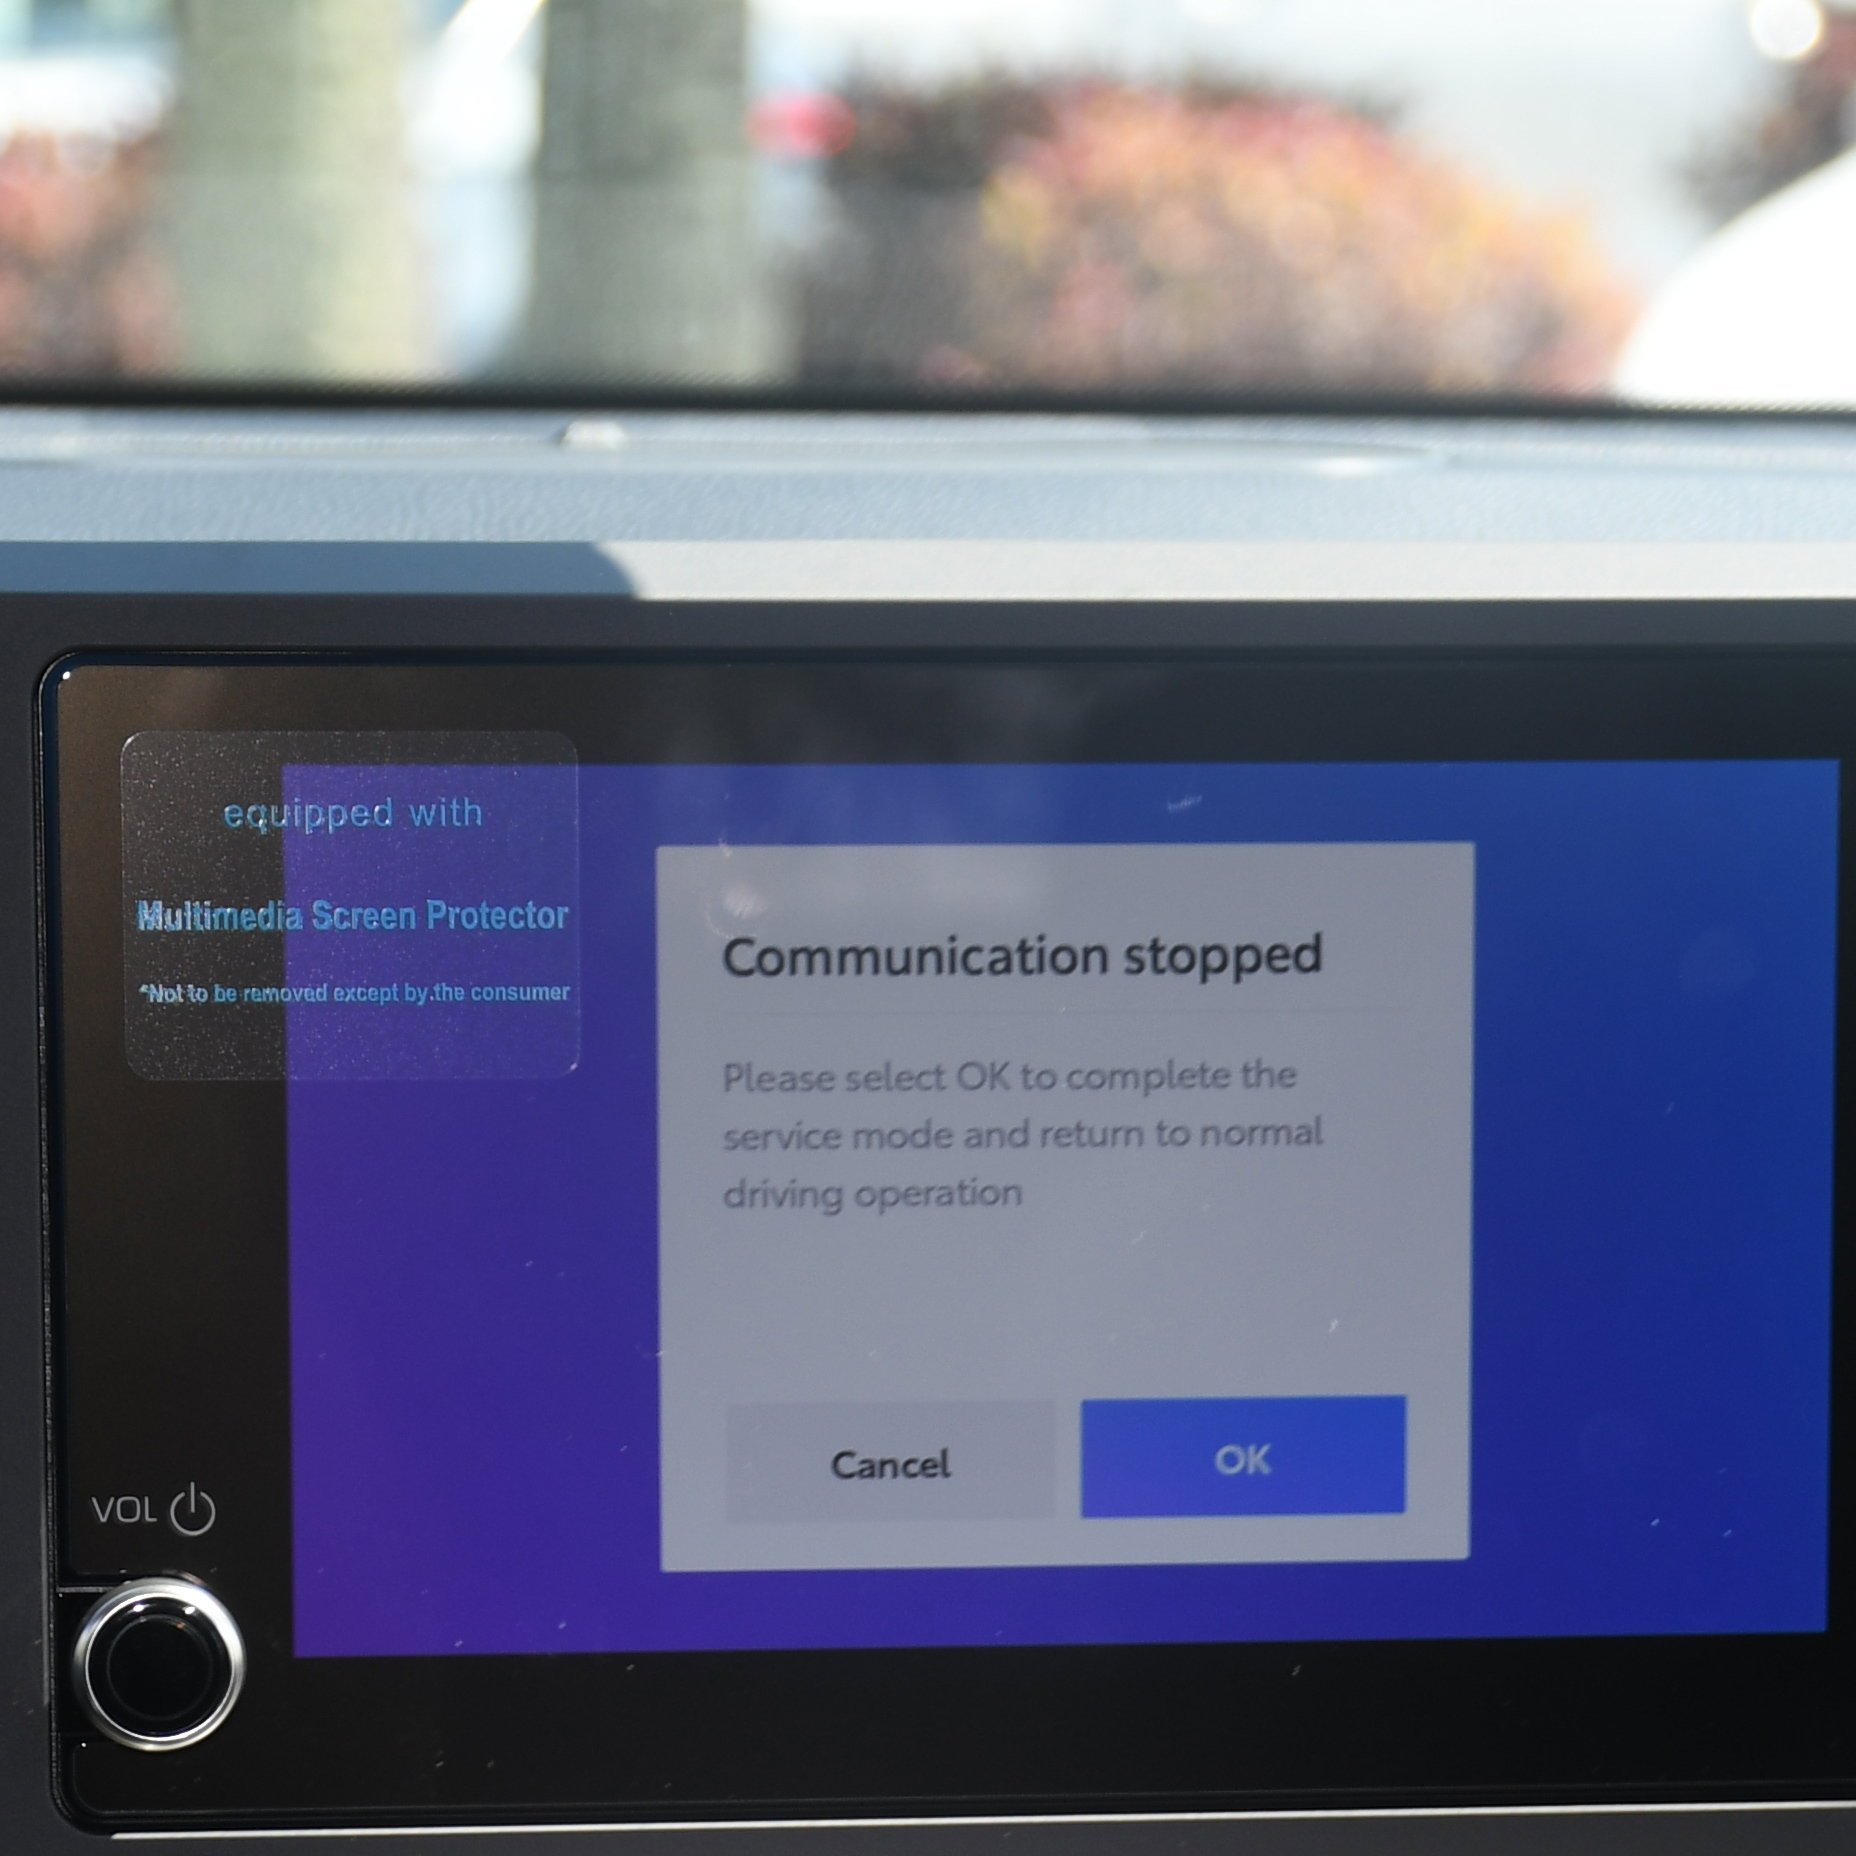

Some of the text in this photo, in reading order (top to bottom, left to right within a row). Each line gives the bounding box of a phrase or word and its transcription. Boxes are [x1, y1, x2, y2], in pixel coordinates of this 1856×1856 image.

[224, 797, 482, 835] equipped with
[136, 900, 568, 931] Multimedia Screen Protector
[723, 933, 1322, 984] Communication stopped
[188, 984, 208, 1002] to
[215, 984, 237, 1002] be
[244, 983, 328, 1002] removed
[334, 983, 398, 1006] except
[405, 983, 428, 1006] by
[433, 983, 464, 1001] the
[471, 986, 571, 1001] consumer
[724, 1059, 1297, 1098] Please select OK to complete the
[723, 1116, 1323, 1152] service mode and return to normal
[723, 1178, 1022, 1215] driving operation
[832, 1449, 951, 1481] Cancel
[1216, 1443, 1272, 1476] OK
[91, 1496, 158, 1523] VOL
